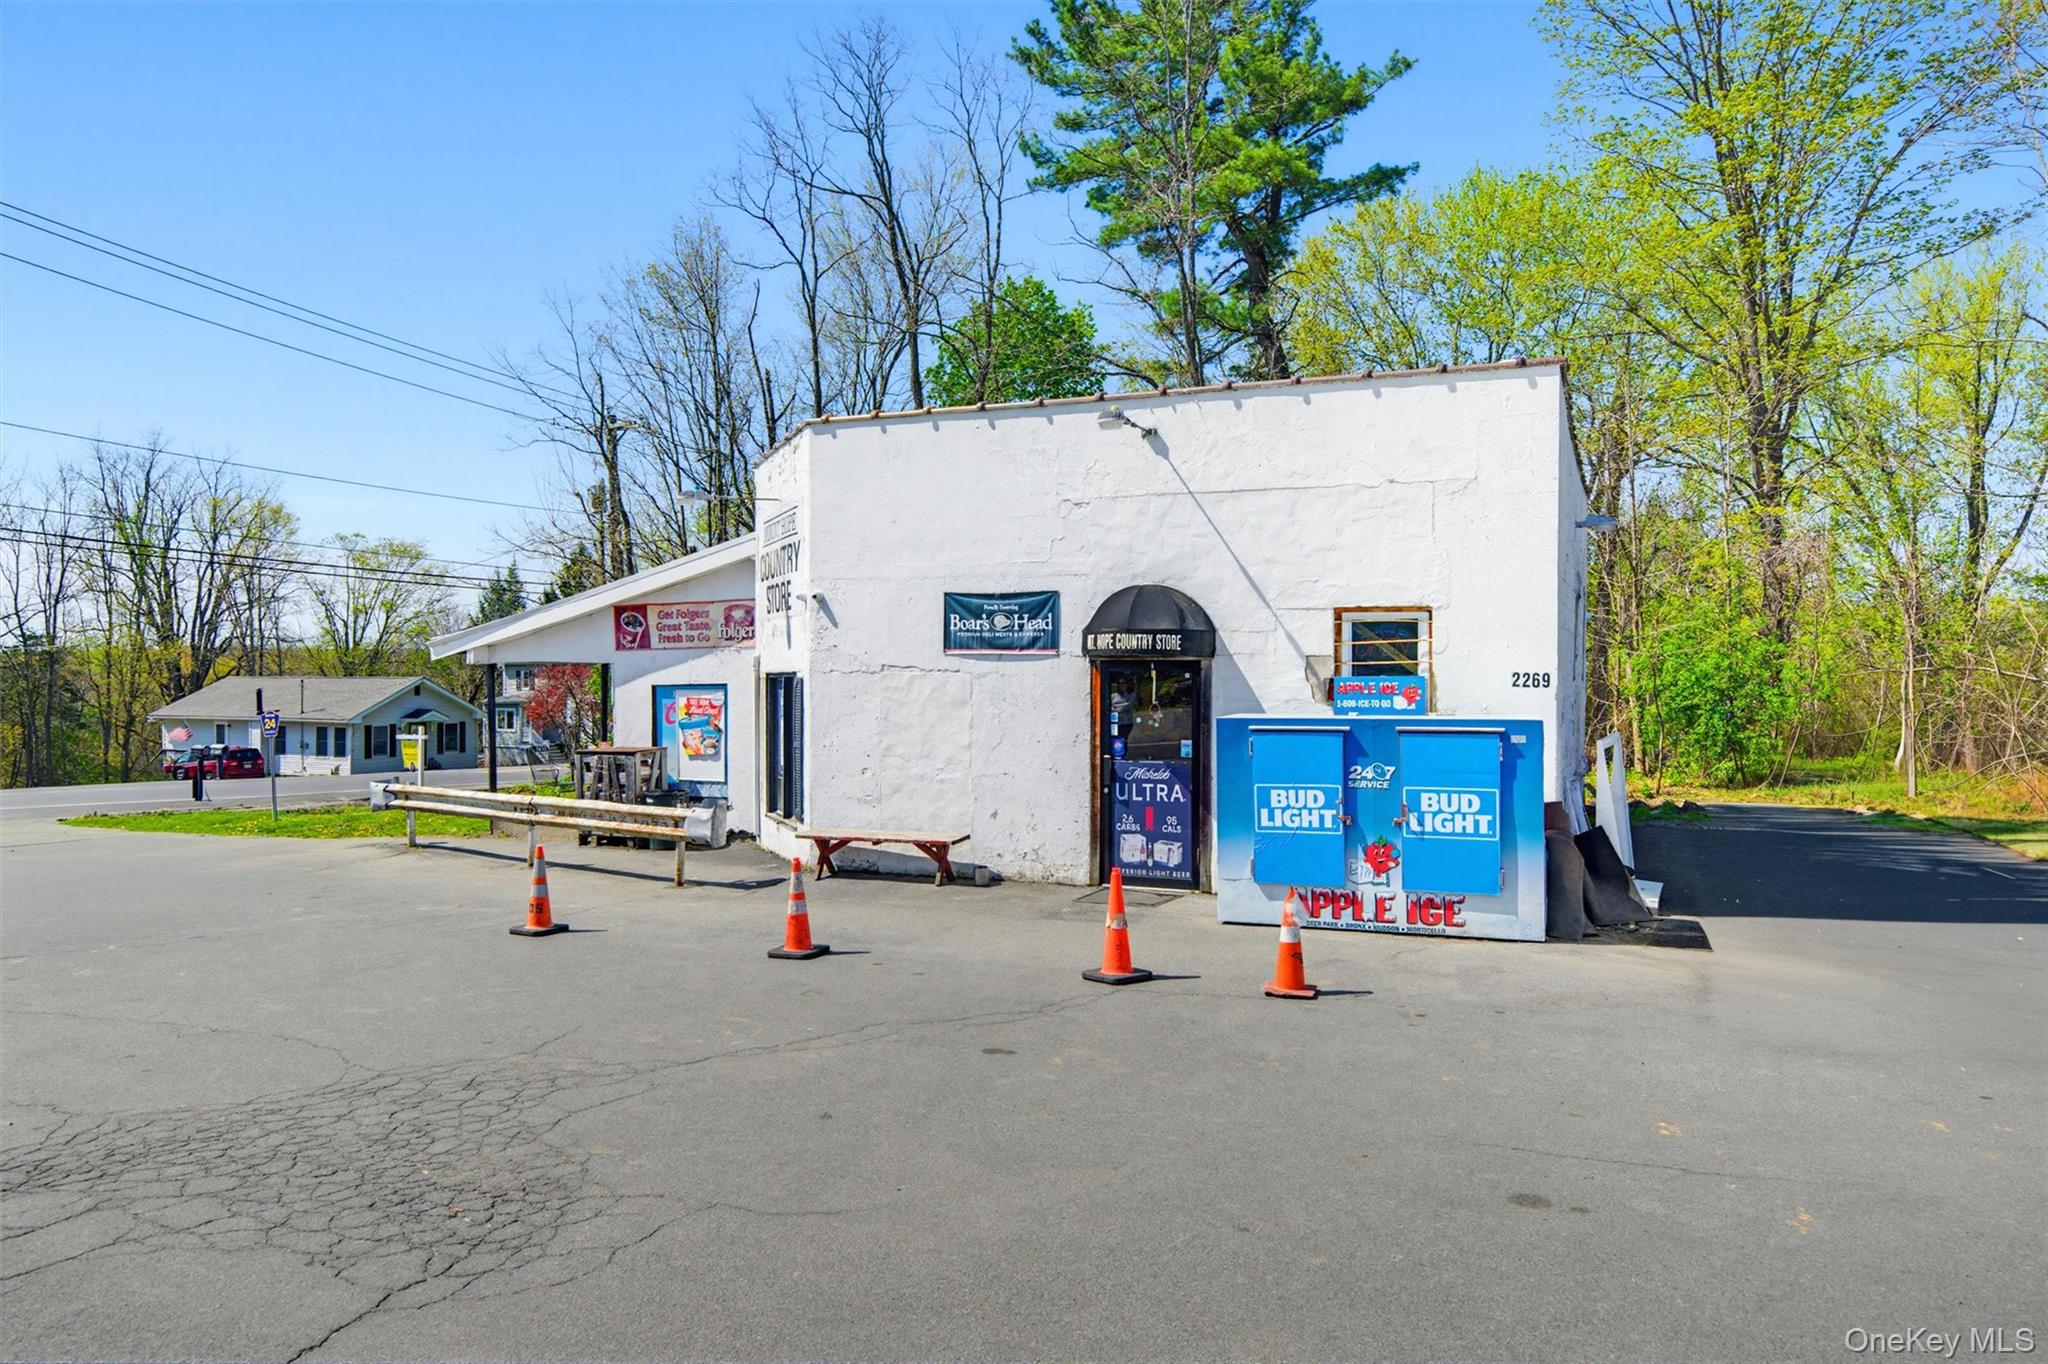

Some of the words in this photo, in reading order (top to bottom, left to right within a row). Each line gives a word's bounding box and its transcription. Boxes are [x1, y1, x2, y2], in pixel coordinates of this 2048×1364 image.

[760, 540, 801, 583] COUNTRY
[766, 581, 792, 614] STORE
[657, 610, 674, 620] Get
[675, 609, 710, 621] Folgers
[949, 613, 990, 630] Boar's
[1013, 613, 1053, 630] Head
[656, 622, 682, 632] Great
[718, 622, 756, 642] Folger
[658, 633, 683, 644] Fresh
[685, 634, 695, 642] to
[697, 633, 711, 643] Go
[1096, 633, 1114, 649] HOPE
[1116, 633, 1154, 649] COUNTRY
[1155, 634, 1182, 650] STORE
[1512, 672, 1551, 688] 2269
[1337, 681, 1377, 695] APPLE
[1379, 681, 1400, 695] ICE
[1380, 700, 1392, 708] GO
[264, 719, 276, 729] 24
[1124, 766, 1171, 780] Michelob
[1348, 780, 1391, 789] SERVICE
[1116, 782, 1185, 802] ULTRA
[1270, 789, 1326, 808] BUD
[1420, 792, 1481, 813] BUD
[1166, 816, 1178, 825] 95
[1260, 808, 1337, 828] LIGHT
[1409, 812, 1493, 834] LIGHT
[1116, 822, 1141, 831] CARBS
[1162, 825, 1182, 833] CALS
[1121, 867, 1147, 875] PERIOR
[1149, 869, 1170, 877] LIGHT
[1406, 891, 1467, 928] ICE
[1406, 926, 1446, 934] MONTICELLO
